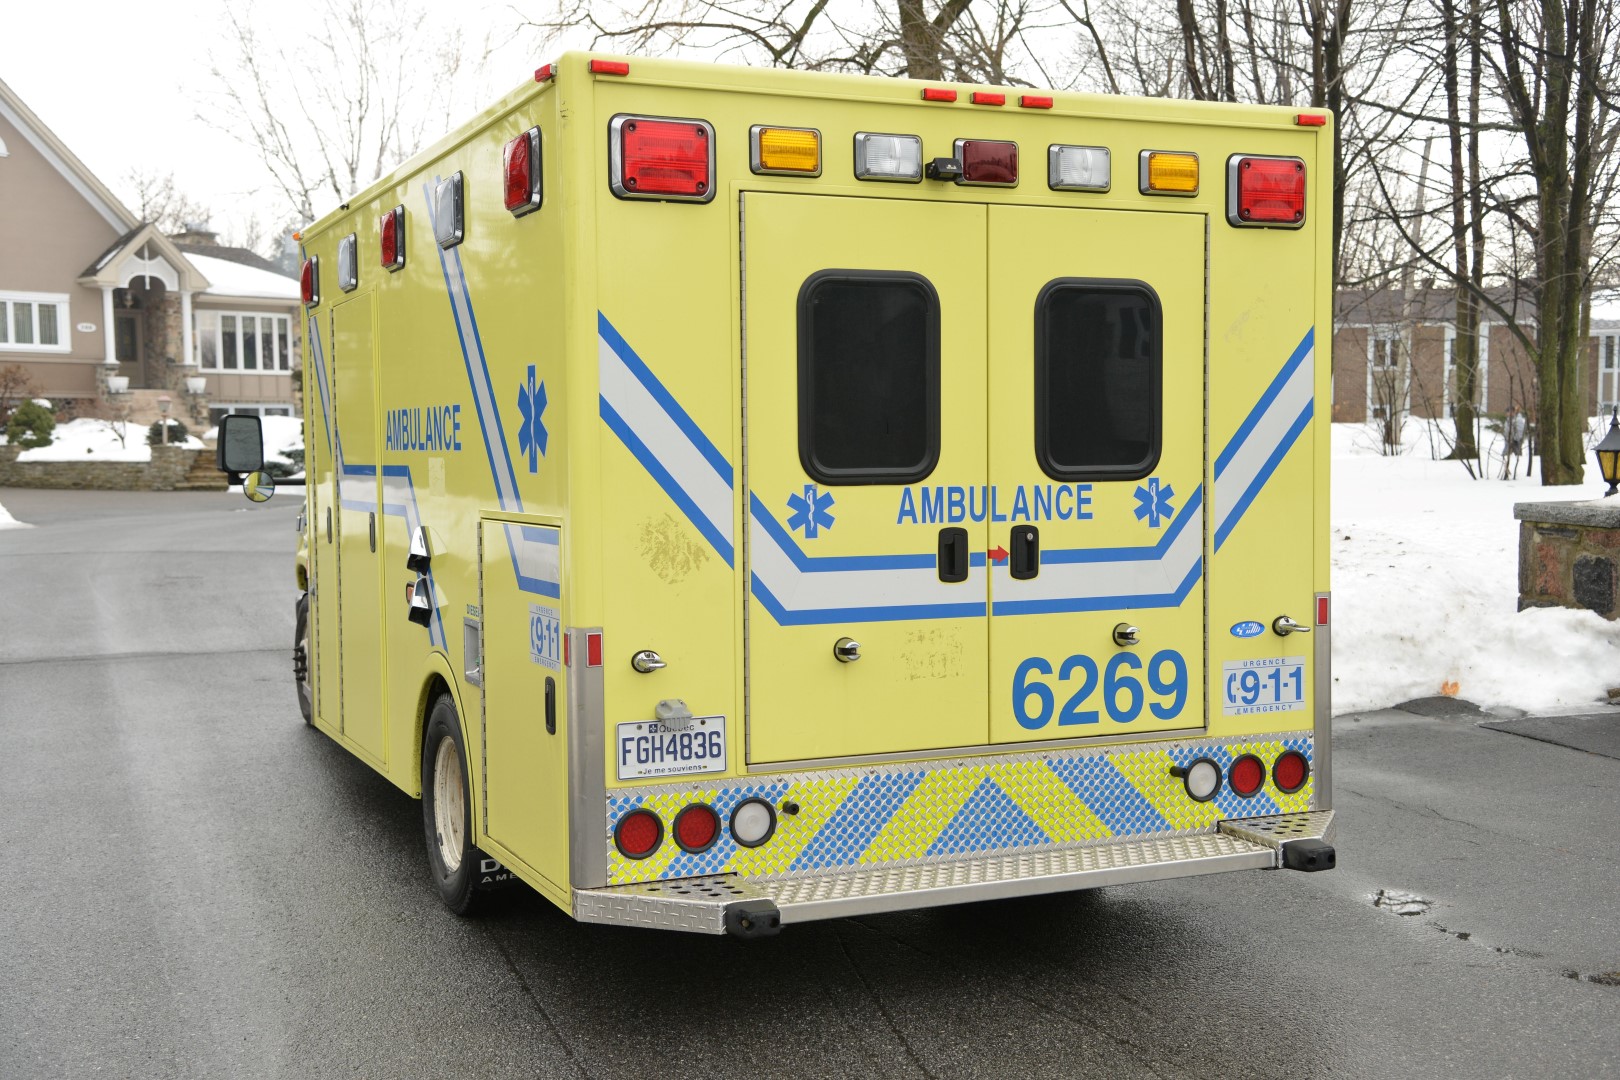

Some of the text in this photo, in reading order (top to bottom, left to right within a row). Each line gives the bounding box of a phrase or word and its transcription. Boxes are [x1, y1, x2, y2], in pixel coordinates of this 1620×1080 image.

[386, 405, 462, 451] AMBULANCE
[897, 484, 1093, 525] AMBULANCE
[536, 605, 553, 616] URGENCE
[535, 616, 560, 661] 9-1-1
[1243, 658, 1286, 667] URGENCE
[1012, 649, 1188, 730] 6269
[1240, 666, 1302, 705] 9-1-1
[1236, 704, 1293, 714] EMERGENCY
[621, 731, 721, 765] FGH4836
[668, 765, 702, 773] souviens
